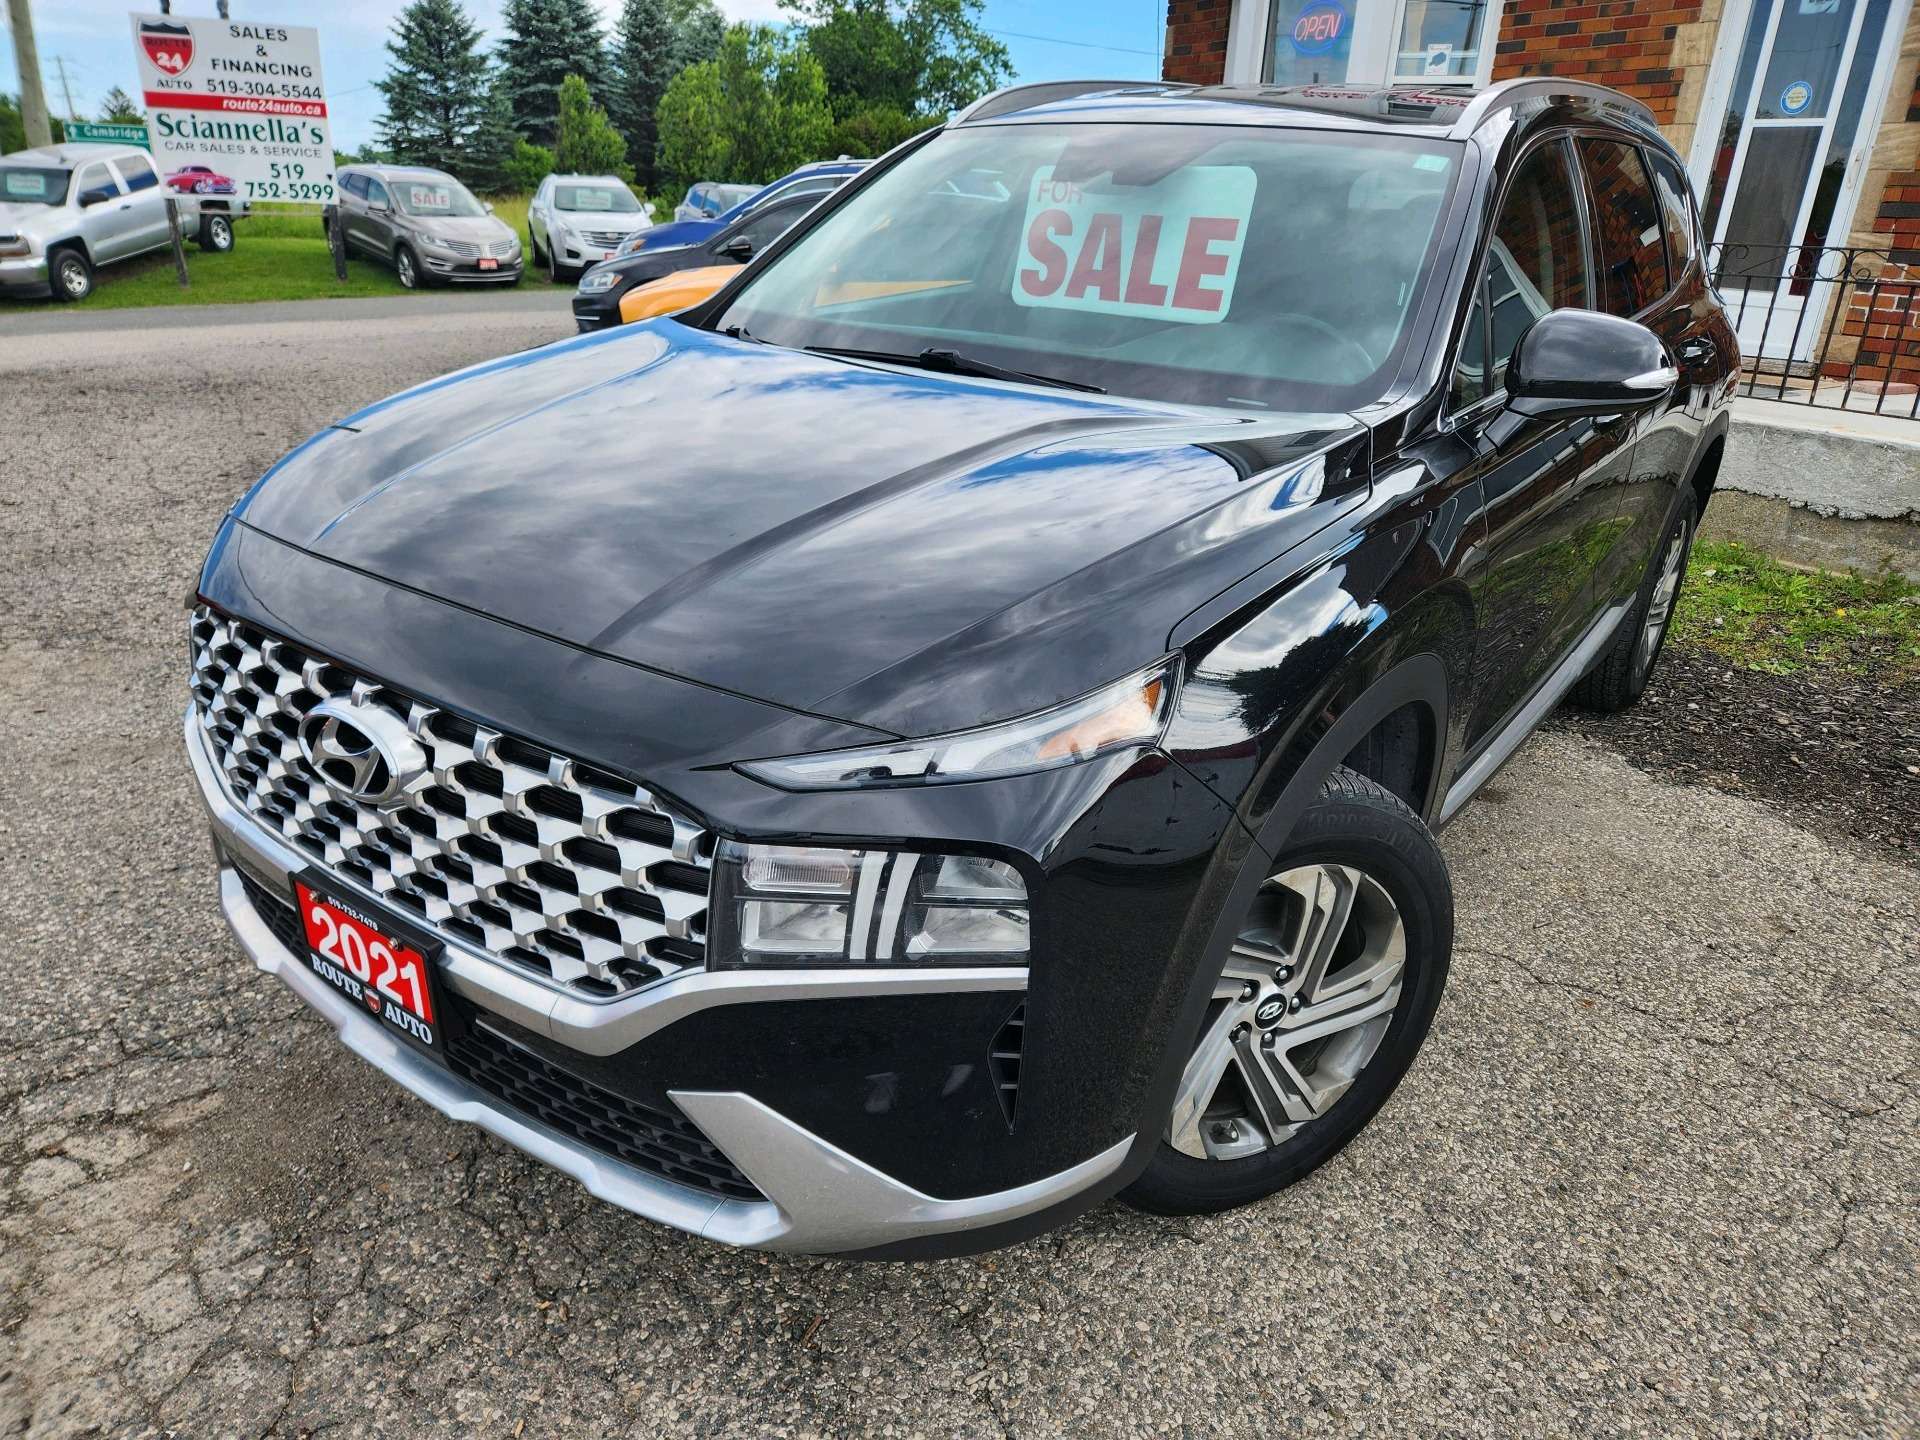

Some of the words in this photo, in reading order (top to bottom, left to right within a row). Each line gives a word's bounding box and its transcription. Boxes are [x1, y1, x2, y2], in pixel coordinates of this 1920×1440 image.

[229, 25, 288, 42] SALES
[1294, 12, 1341, 41] OPEN
[256, 44, 268, 57] &
[156, 51, 184, 71] 24
[210, 58, 313, 78] FINANCING
[157, 79, 193, 90] AUTO
[207, 79, 322, 99] 519-304-5544
[222, 99, 321, 116] route24auto.ca
[83, 125, 144, 141] Cambridge
[156, 112, 324, 145] Sciannella's
[164, 141, 195, 152] CAR
[200, 143, 246, 155] SALES
[250, 146, 259, 155] &
[264, 146, 322, 159] SERVICE
[270, 163, 304, 180] 519
[245, 182, 334, 200] 752-5299
[413, 191, 449, 206] SALE
[1036, 179, 1084, 204] FOR
[1020, 208, 1240, 312] SALE
[312, 906, 425, 1020] 2021
[310, 953, 363, 1001] ROUTE
[384, 1001, 433, 1045] AUTO
